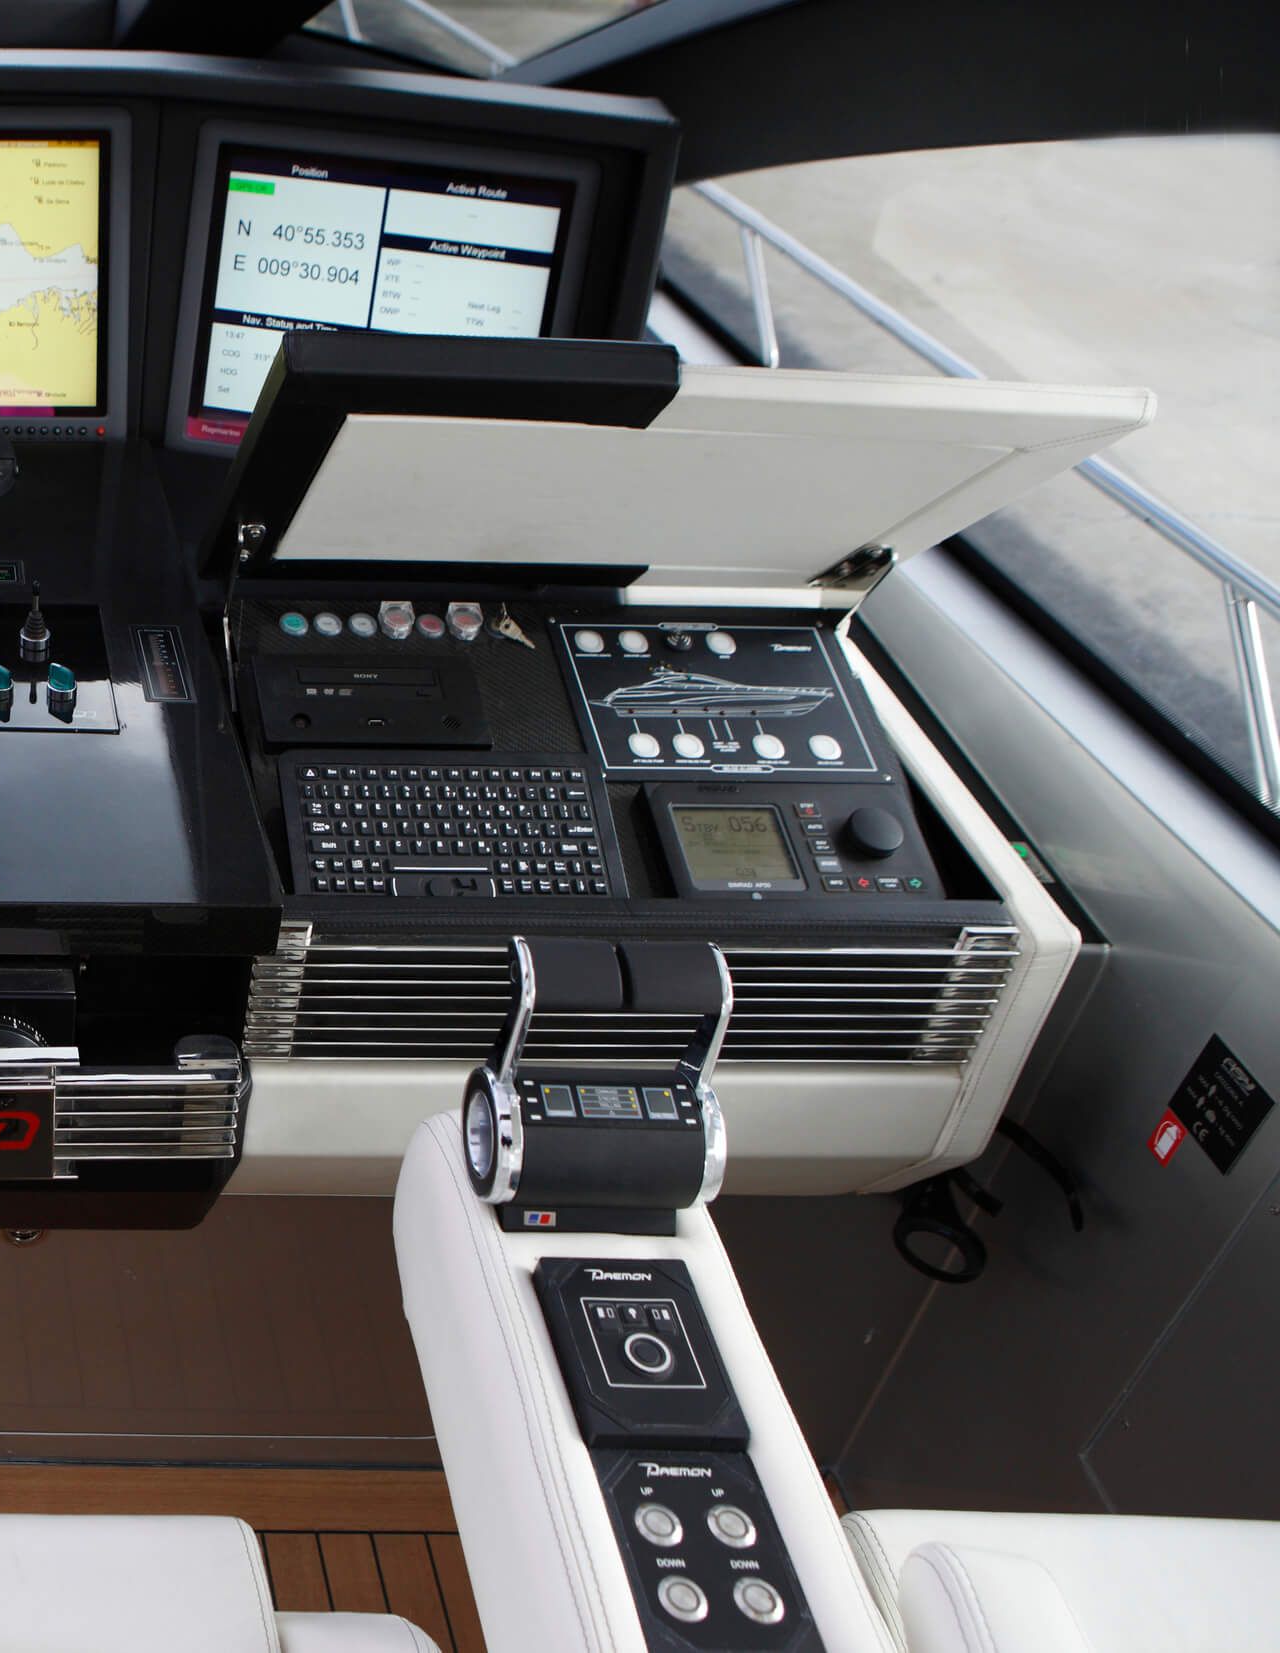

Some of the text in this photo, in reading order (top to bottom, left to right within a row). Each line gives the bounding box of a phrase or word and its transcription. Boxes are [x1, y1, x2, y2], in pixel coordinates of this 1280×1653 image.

[291, 164, 328, 178] Position
[446, 182, 508, 200] Active Route
[237, 219, 365, 250] N 40°55.353
[429, 241, 507, 260] Active Waypoint
[233, 254, 360, 285] E 009°30.904
[242, 314, 263, 326] Nav.
[265, 317, 294, 330] Status
[295, 321, 314, 330] and
[728, 815, 768, 832] 056
[584, 1268, 652, 1282] DAEMON
[638, 1462, 712, 1478] DAEMON
[640, 1486, 724, 1497] UP UP
[656, 1558, 760, 1570] DOWN DOWN
